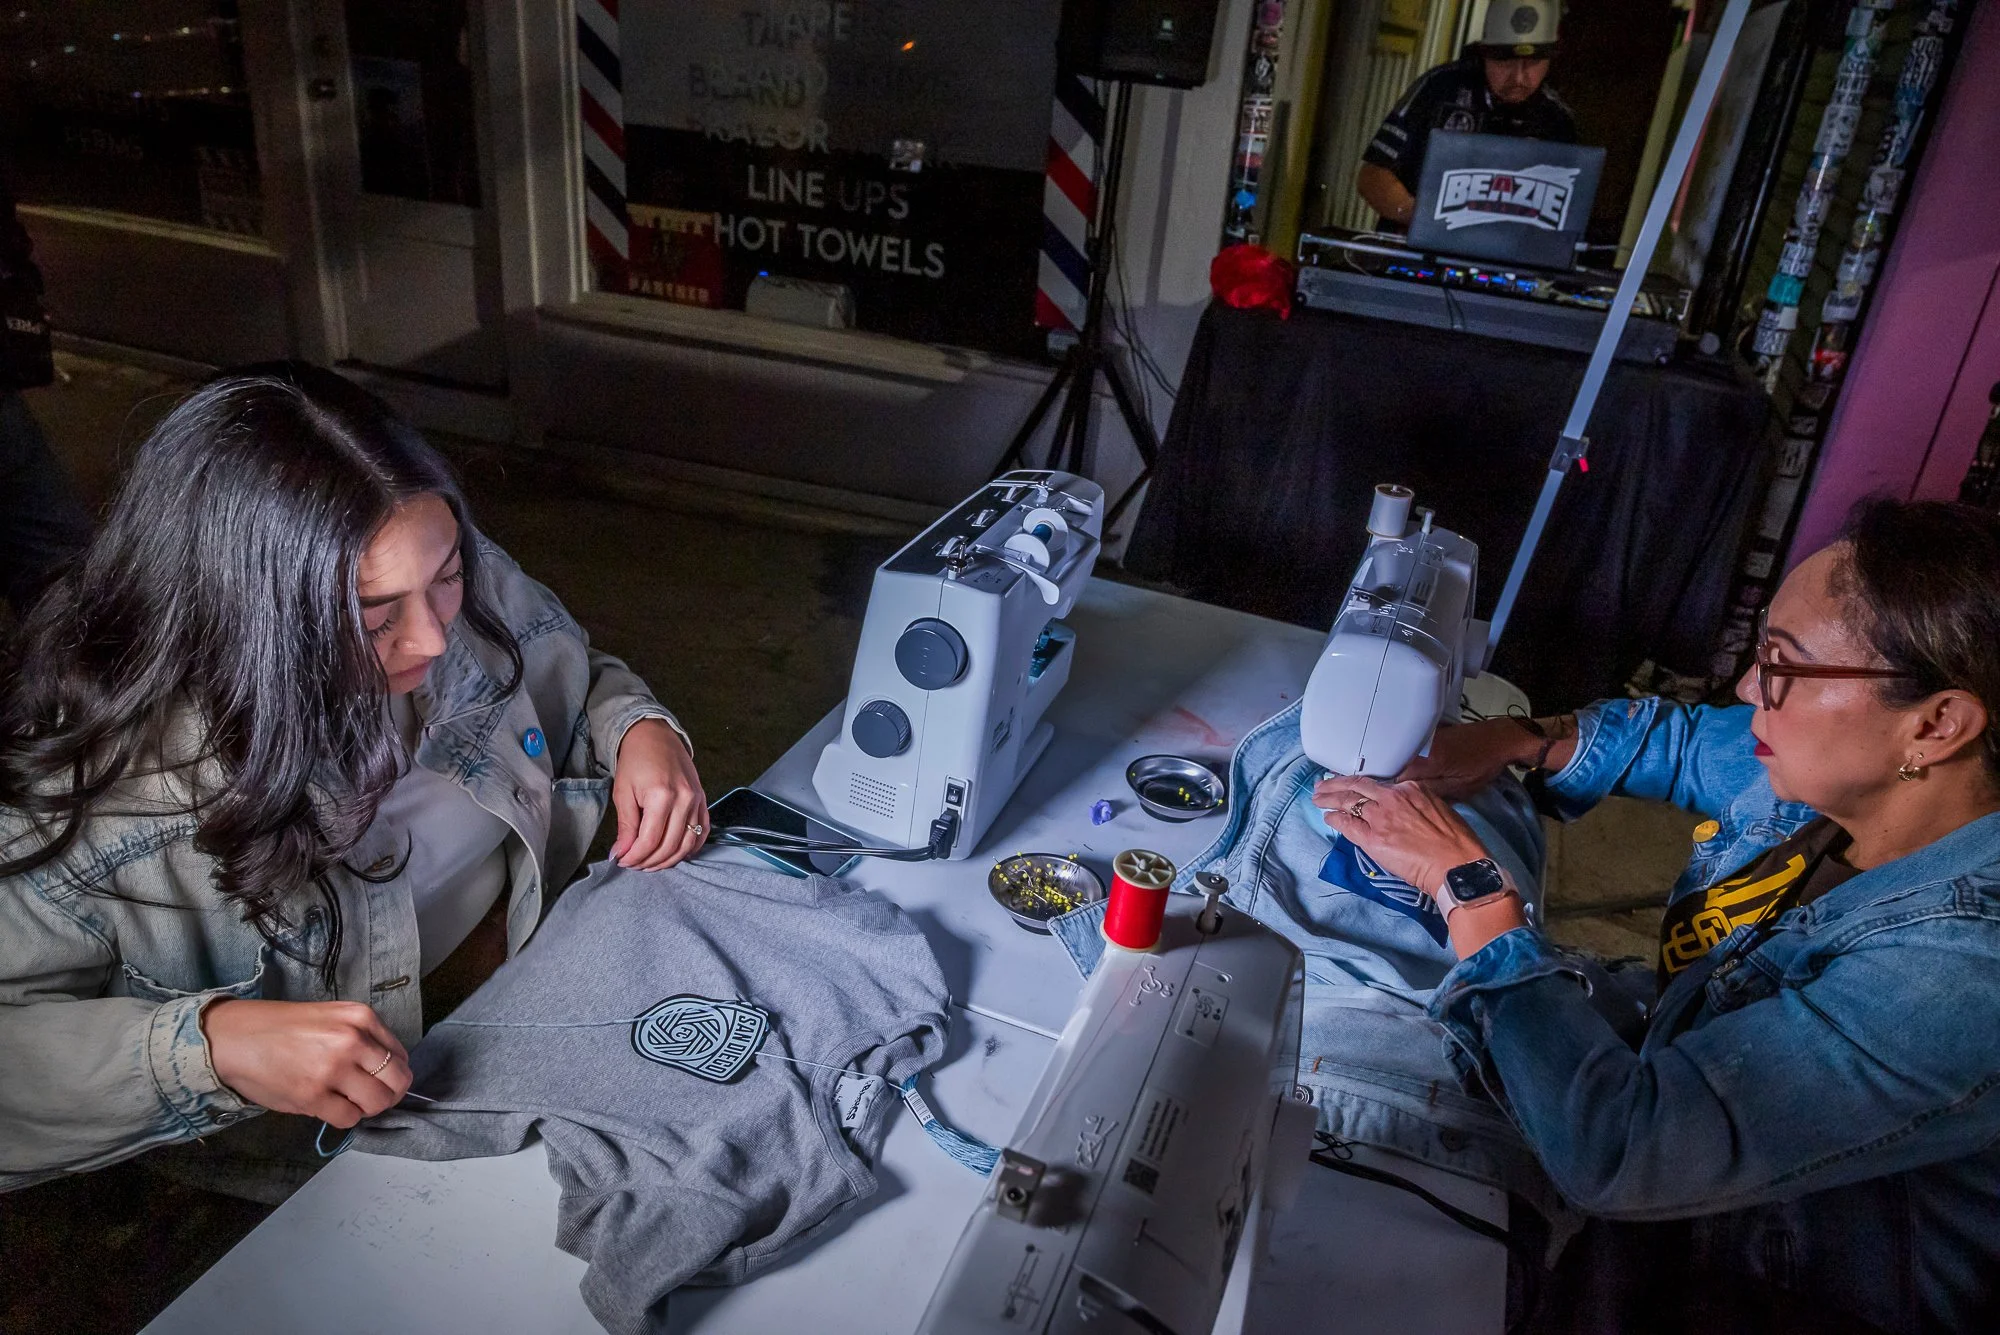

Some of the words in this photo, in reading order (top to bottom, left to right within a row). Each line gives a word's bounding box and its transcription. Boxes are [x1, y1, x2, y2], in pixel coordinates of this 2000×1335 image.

[748, 164, 826, 209] LINE
[840, 178, 910, 221] UPS
[714, 210, 787, 254] HOT
[797, 223, 946, 280] TOWELS
[731, 1014, 757, 1044] SAN
[704, 1042, 747, 1074] DIEGO
